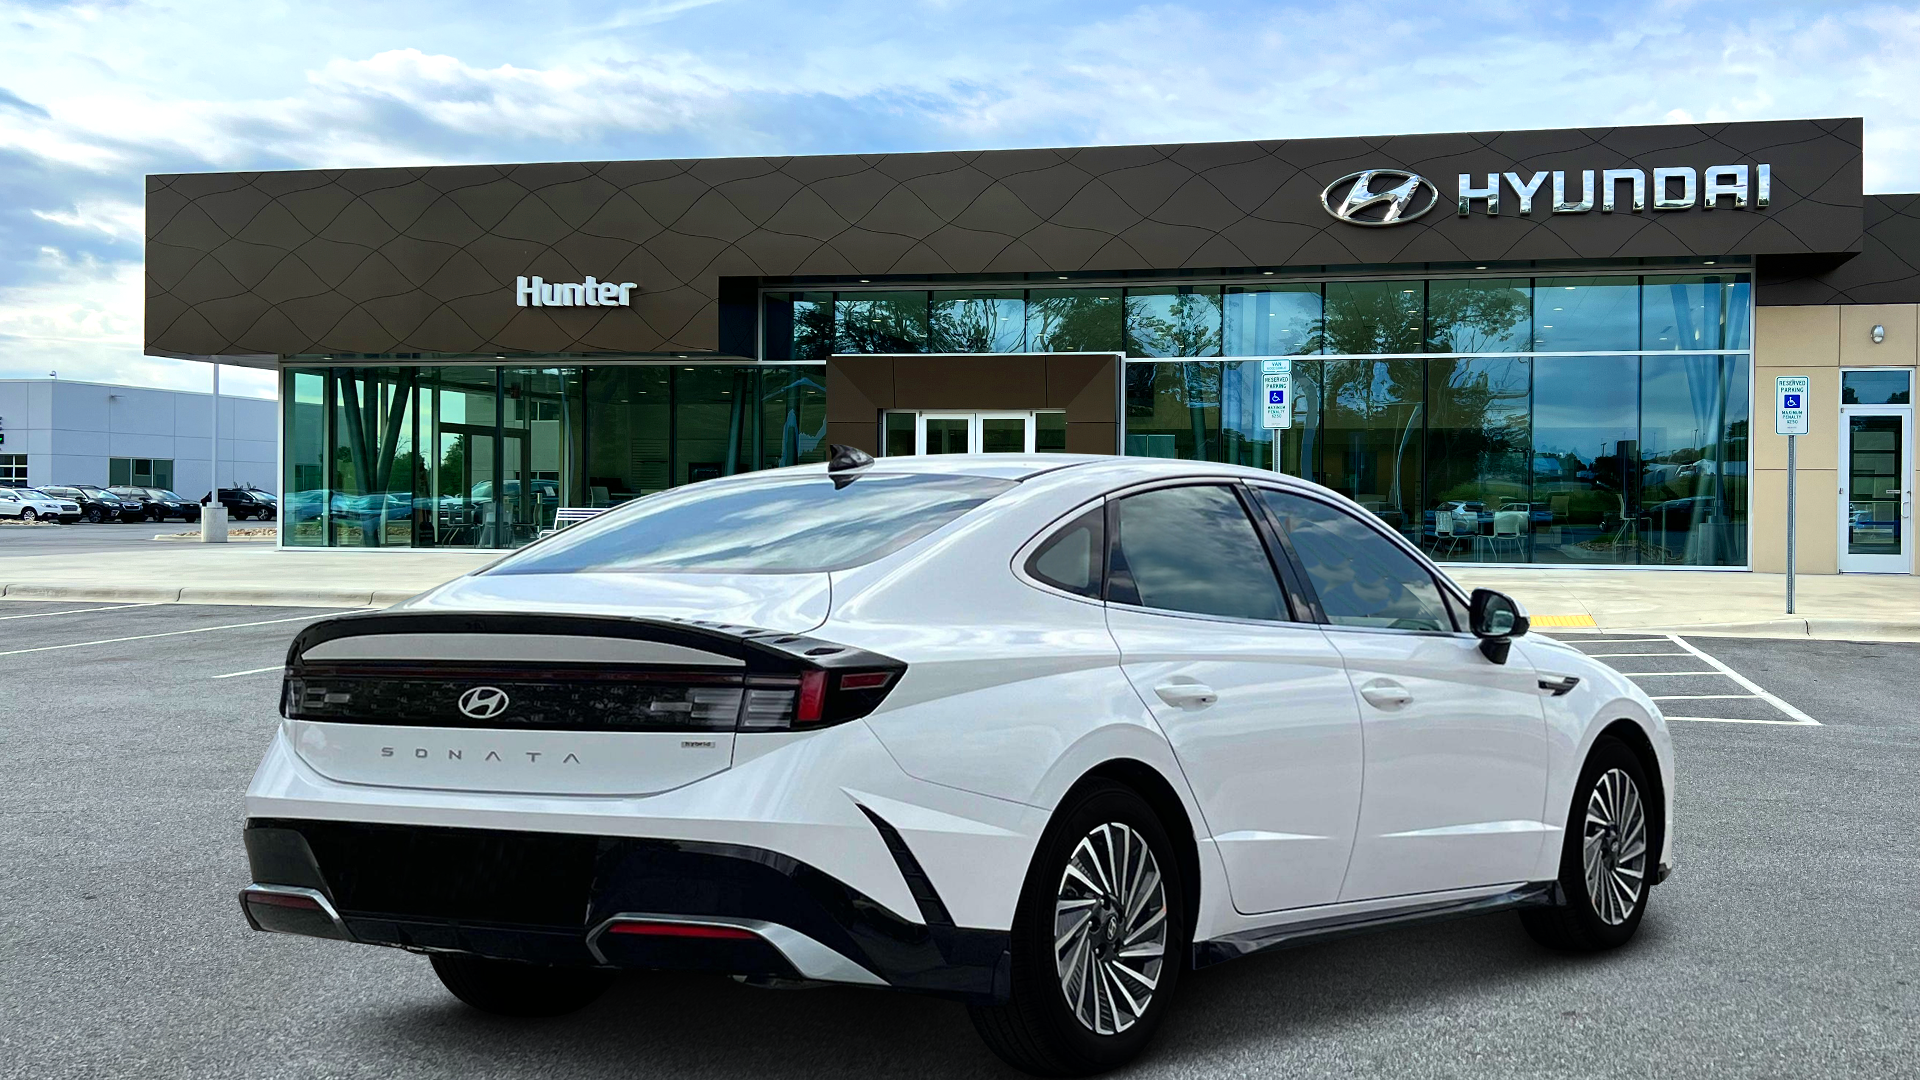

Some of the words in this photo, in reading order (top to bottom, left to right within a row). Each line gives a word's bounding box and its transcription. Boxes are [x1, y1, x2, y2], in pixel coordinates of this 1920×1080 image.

[1458, 163, 1771, 217] HYUNDAI
[516, 275, 638, 307] Hunter
[381, 747, 580, 764] SONATA
